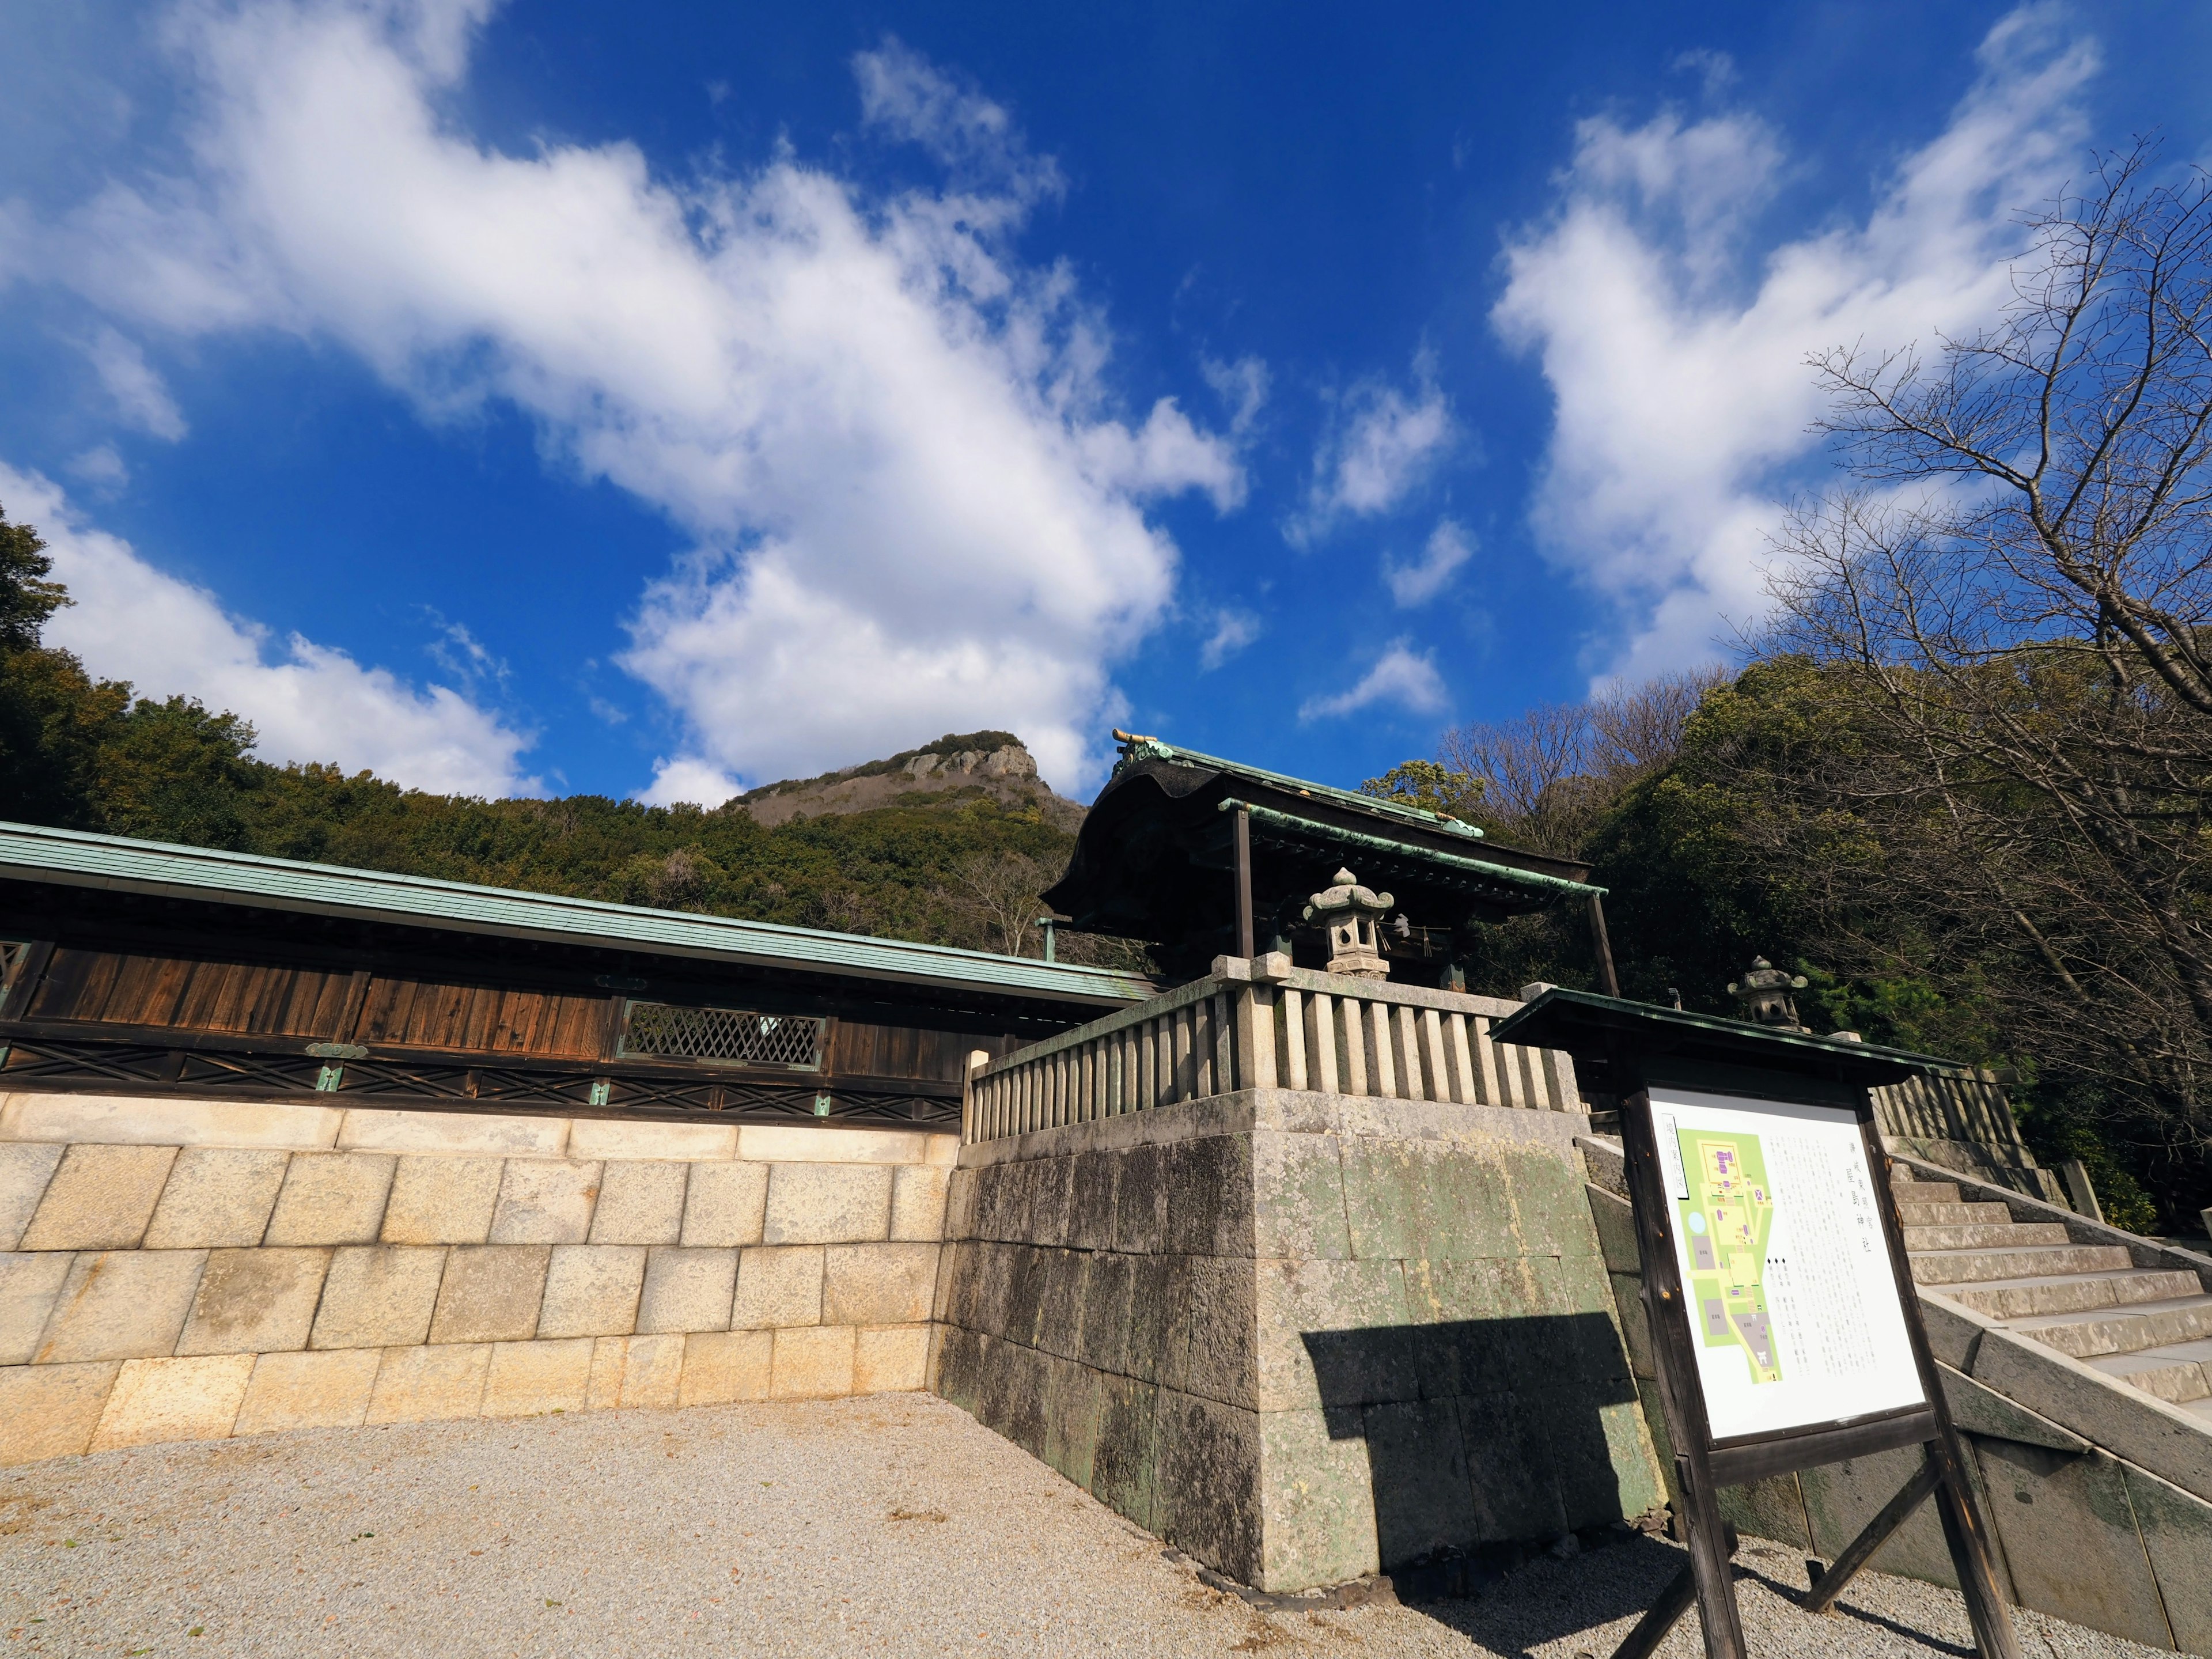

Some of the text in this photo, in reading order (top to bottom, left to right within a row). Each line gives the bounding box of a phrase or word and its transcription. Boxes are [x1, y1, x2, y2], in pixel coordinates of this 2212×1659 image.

[1666, 1122, 1684, 1188] 境内案内図
[1846, 1168, 1872, 1253] 屋島神社
